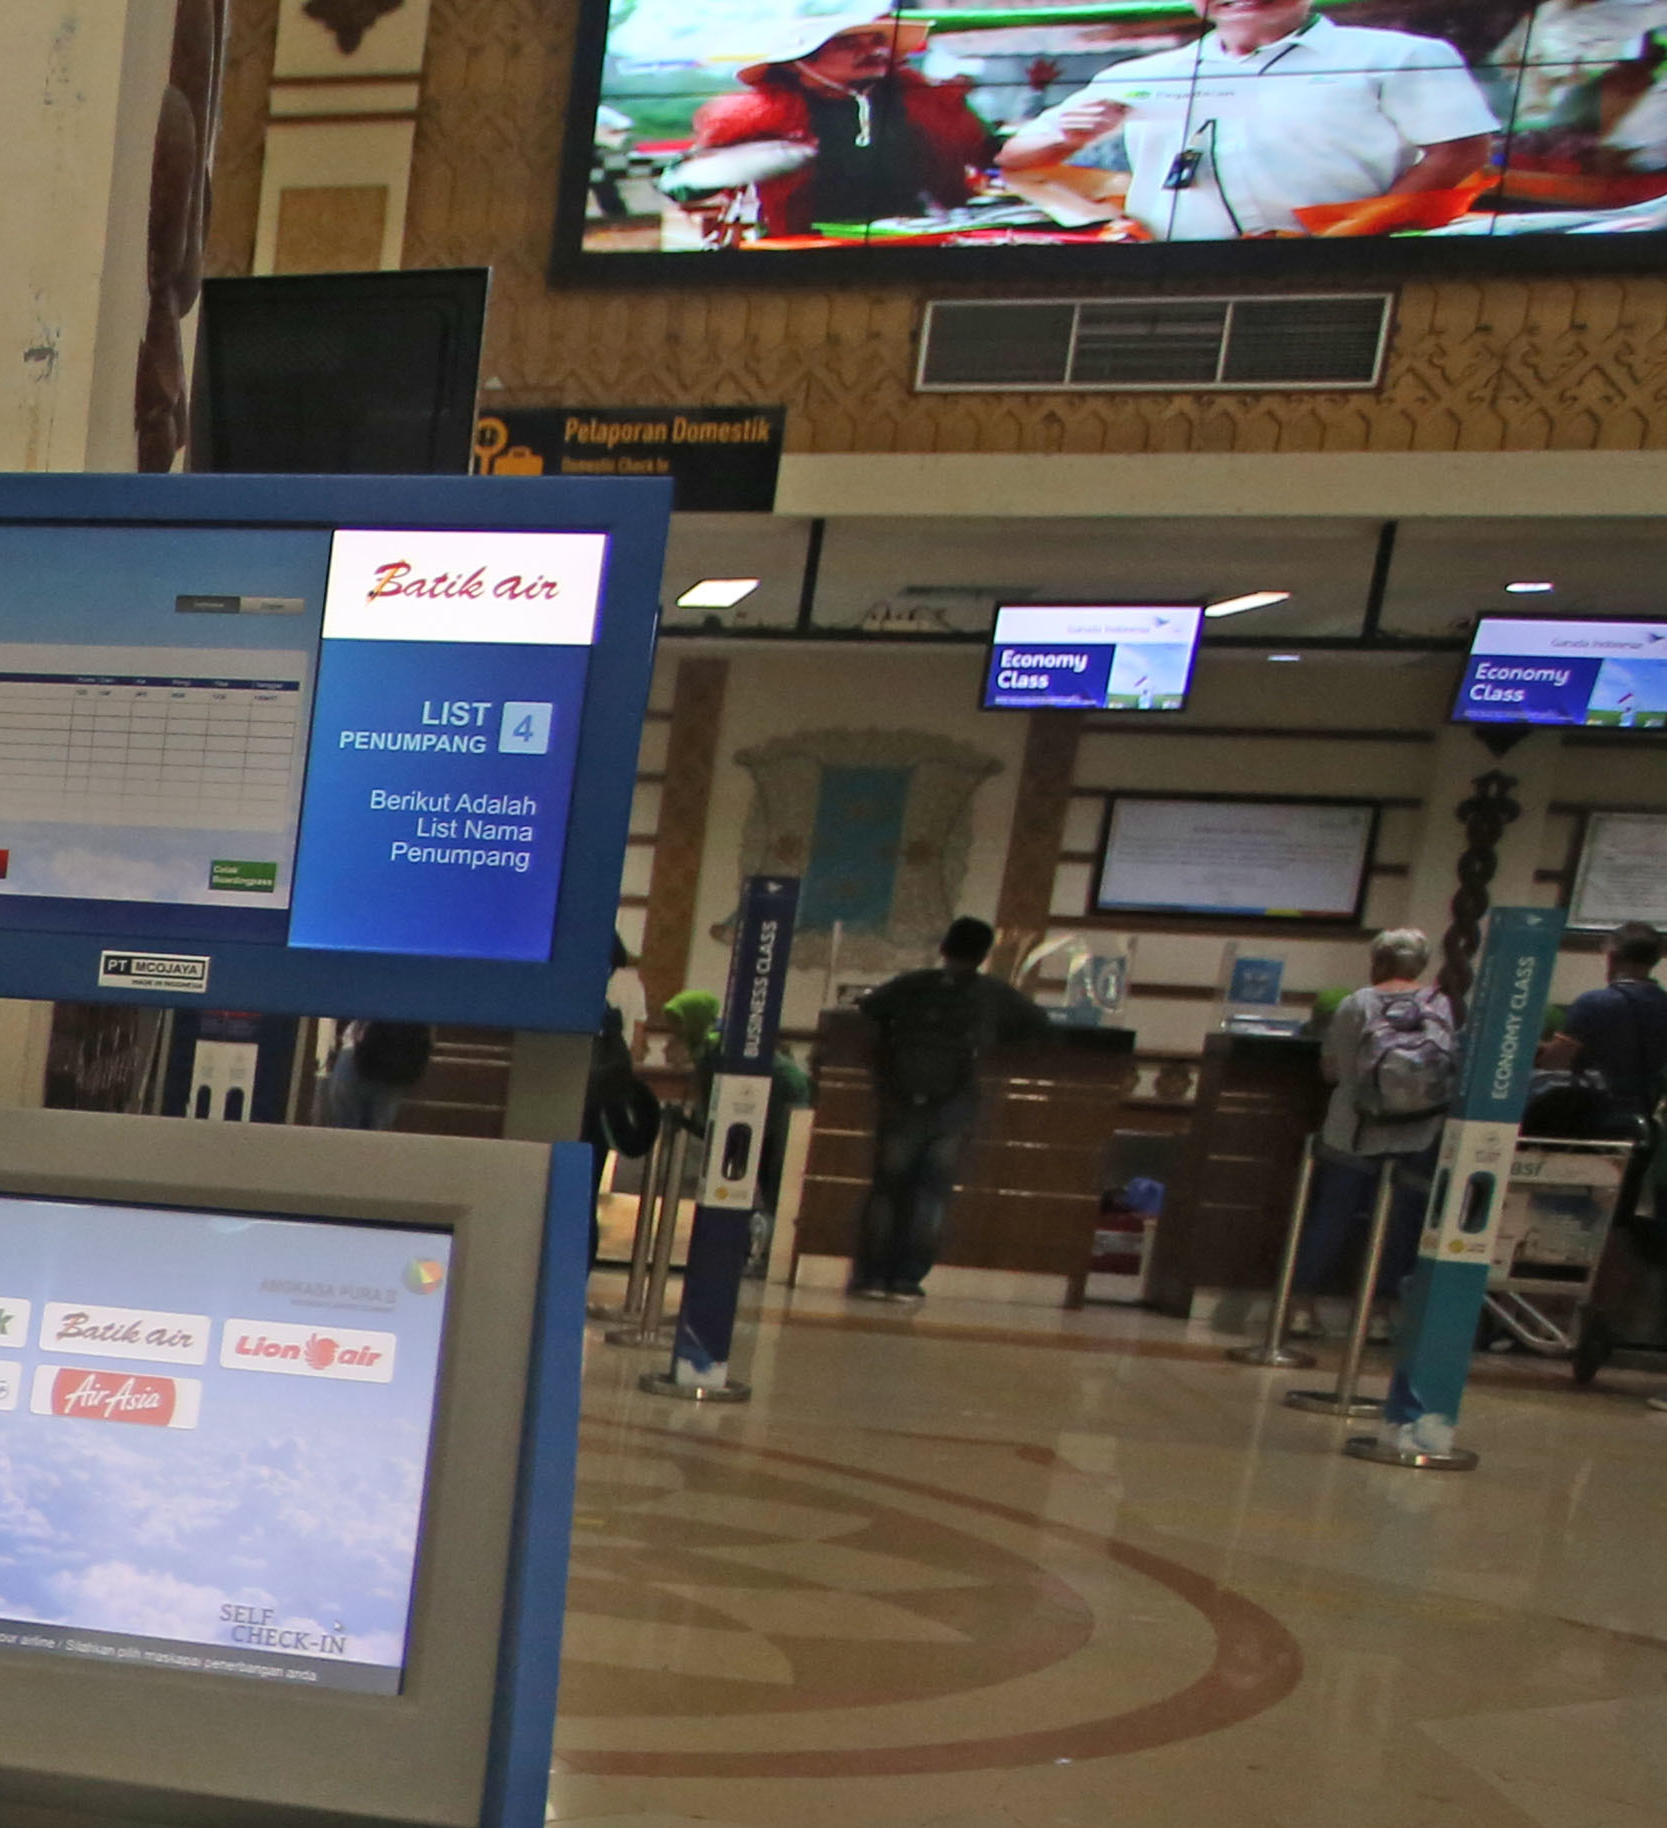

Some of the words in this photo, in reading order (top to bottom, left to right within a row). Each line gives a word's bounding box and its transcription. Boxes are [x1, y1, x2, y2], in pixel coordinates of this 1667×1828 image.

[564, 416, 667, 449] Pelaporan
[671, 415, 770, 443] Domestik
[365, 559, 488, 605] Batik
[492, 574, 560, 600] air
[1000, 649, 1088, 673] Economy
[1474, 662, 1571, 687] Economy
[997, 669, 1050, 689] Class
[1470, 683, 1525, 702] Class
[421, 700, 491, 727] LIST
[512, 714, 535, 742] 4
[338, 730, 488, 754] PENUMPANG
[370, 789, 451, 813] Berikut
[455, 793, 537, 816] Adalah
[416, 817, 458, 838] List
[463, 820, 534, 842] Nama
[390, 841, 531, 873] Penumpang
[107, 959, 127, 973] PT
[135, 961, 197, 975] MCOJAYA
[743, 975, 775, 1059] BUSINESS
[761, 920, 778, 974] CLASS
[1491, 1019, 1525, 1101] ECONOMY
[1512, 954, 1534, 1017] CLASS
[56, 1311, 142, 1344] Batik
[145, 1331, 194, 1349] air
[235, 1335, 301, 1360] Lion
[337, 1345, 383, 1367] air
[220, 1603, 275, 1626] SELF
[231, 1625, 347, 1655] CHECK-IN
[21, 1634, 55, 1649] airline
[286, 1668, 317, 1682] anda
